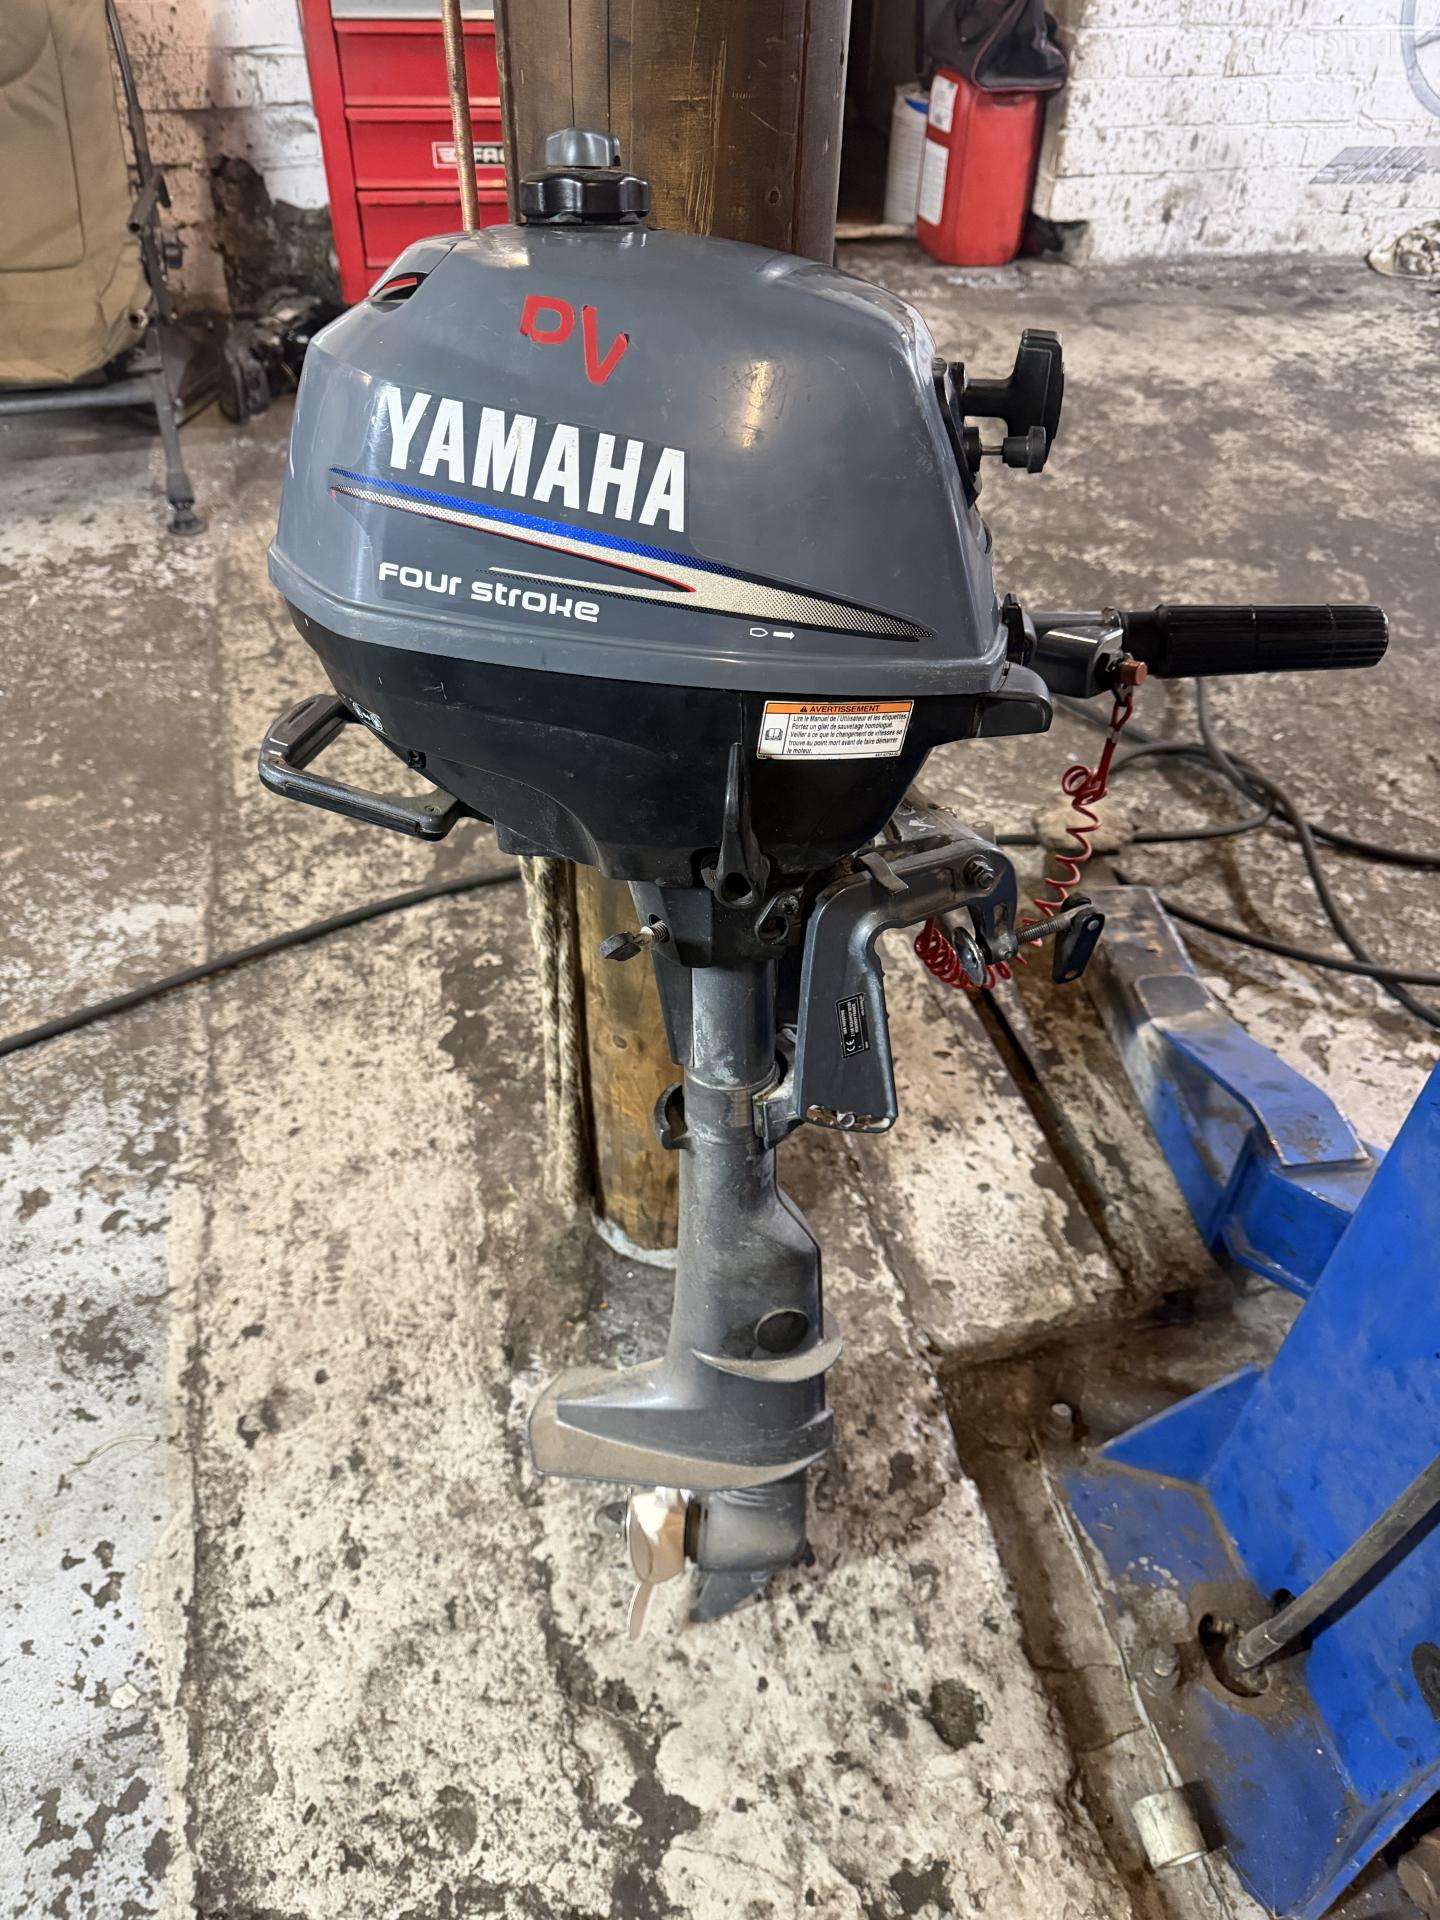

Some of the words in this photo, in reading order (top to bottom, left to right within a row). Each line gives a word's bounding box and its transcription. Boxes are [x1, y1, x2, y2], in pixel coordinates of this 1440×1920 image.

[376, 384, 686, 533] YAMAHA
[809, 705, 881, 713] AVERTISSEMENT
[817, 723, 830, 731] gilet
[837, 723, 864, 731] sauvetage
[835, 730, 868, 739] changement
[875, 737, 898, 745] démarrer
